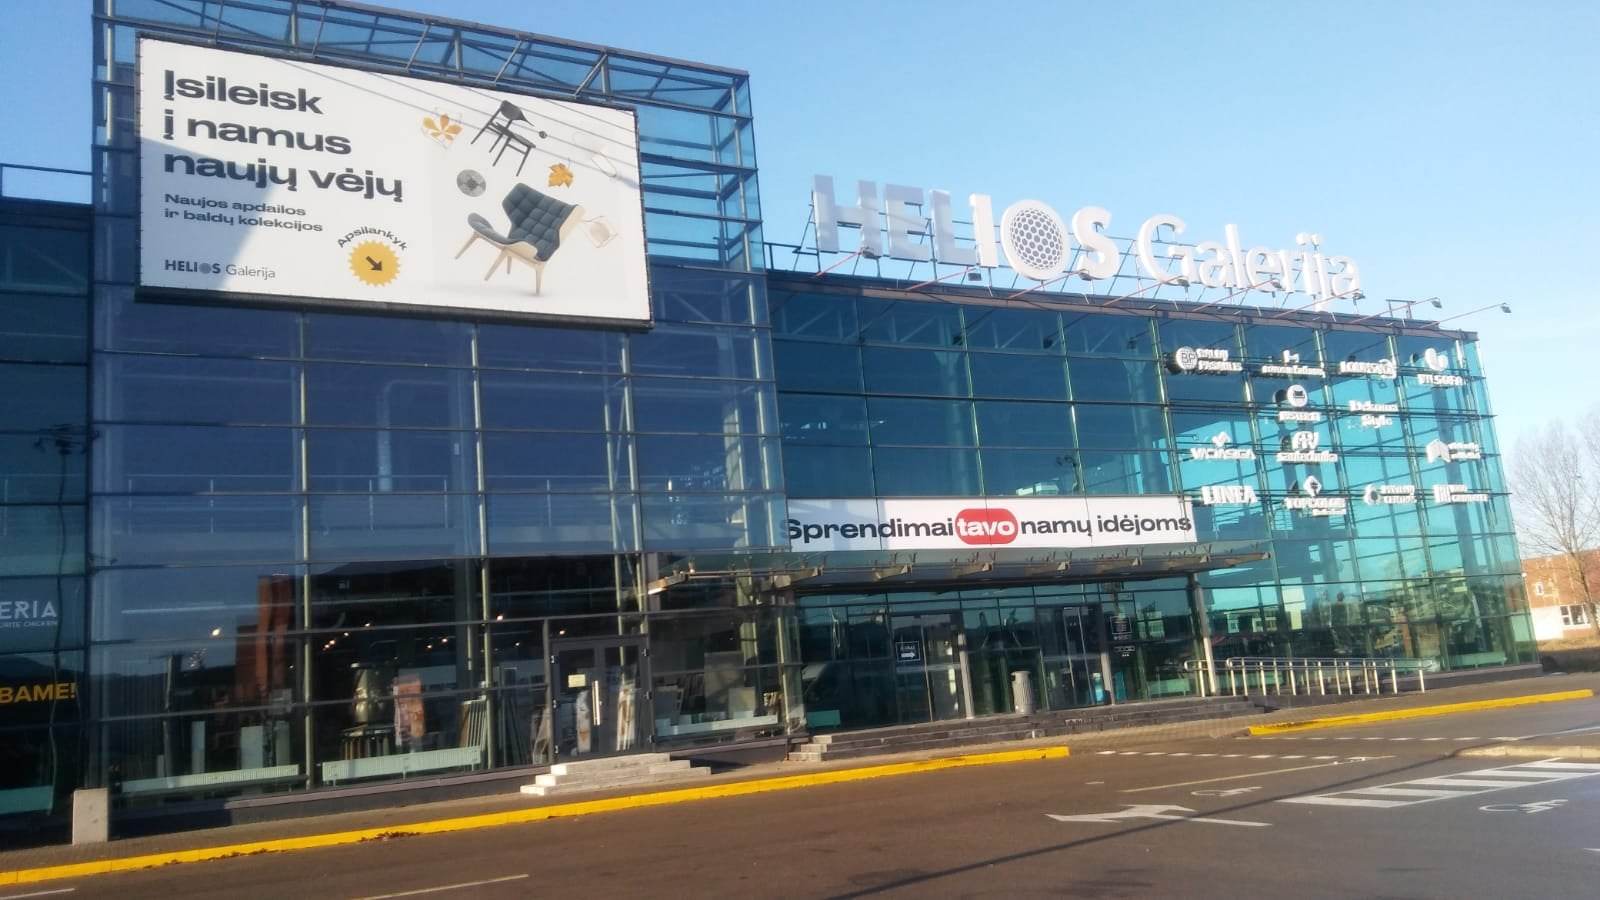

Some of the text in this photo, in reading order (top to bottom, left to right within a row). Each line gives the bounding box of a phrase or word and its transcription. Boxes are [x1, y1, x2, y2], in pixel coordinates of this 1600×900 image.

[163, 69, 324, 115] Įsileisk
[163, 109, 352, 155] į namus
[163, 153, 403, 203] naujų vėjų
[164, 193, 306, 216] Naujos apdailos
[164, 208, 323, 232] ir baldų kolekcijos
[337, 226, 407, 249] Apsilankyk
[811, 174, 1361, 311] HELIOS Galerija
[164, 259, 276, 280] HELIOS Galerija
[1201, 485, 1258, 505] LINEA
[781, 514, 1192, 544] Sprendimai tavo namų idėjoms
